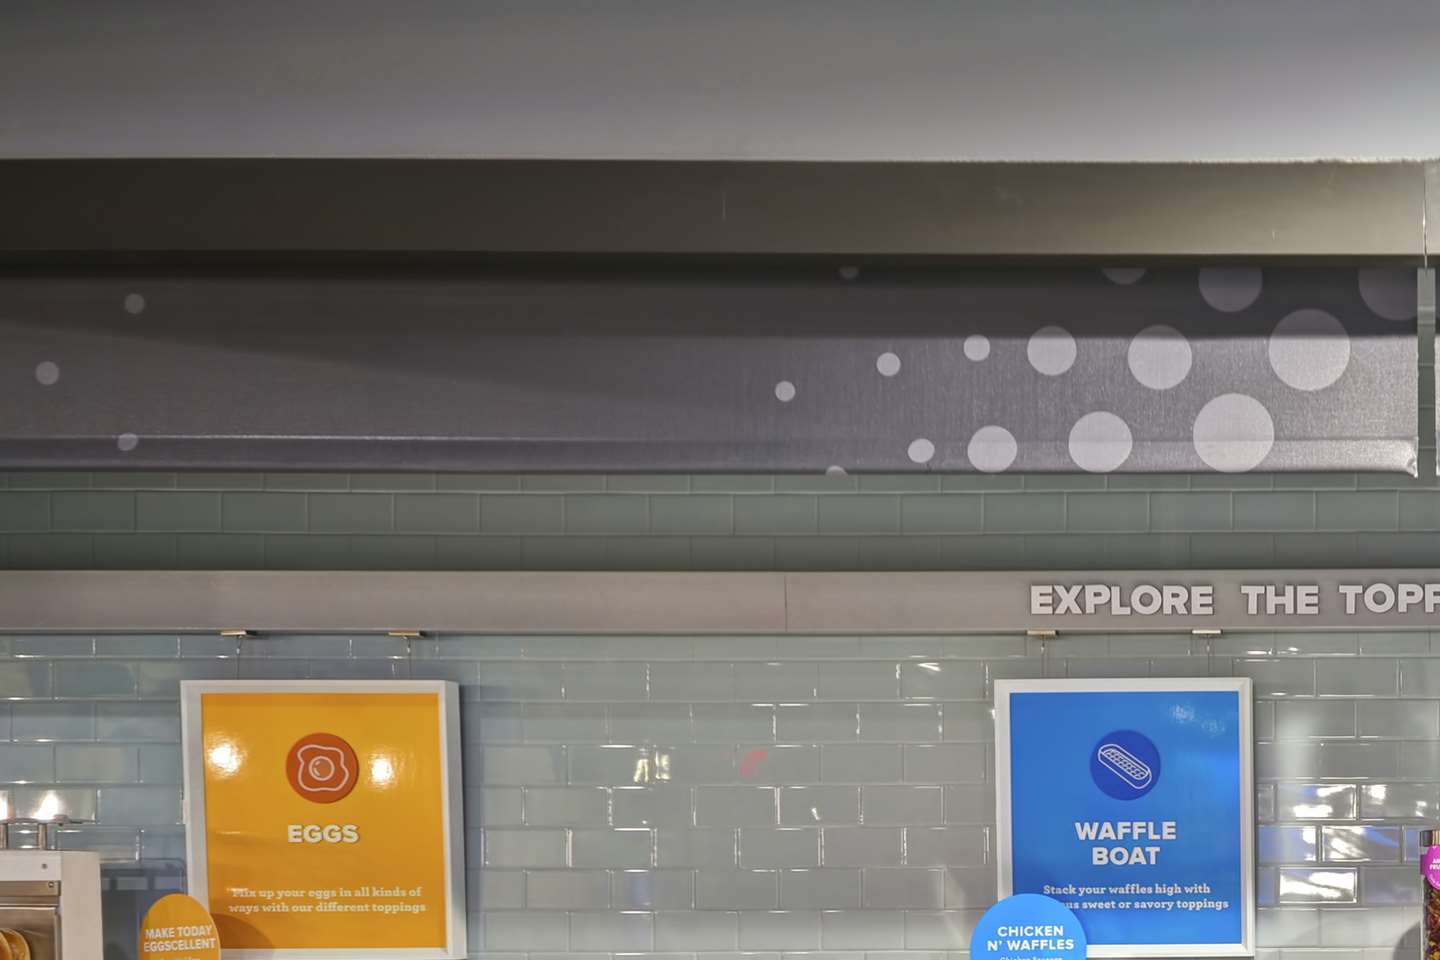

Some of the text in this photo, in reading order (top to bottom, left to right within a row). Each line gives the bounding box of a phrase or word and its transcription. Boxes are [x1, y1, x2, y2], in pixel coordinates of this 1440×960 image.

[1030, 584, 1214, 615] EXPLORE
[1240, 584, 1319, 615] THE
[287, 824, 360, 843] EGGS
[1074, 821, 1177, 840] WAFFLE
[1092, 847, 1160, 865] BOAT
[258, 889, 275, 899] up
[276, 889, 305, 899] your
[308, 889, 336, 899] eggs
[339, 887, 352, 897] in
[354, 887, 370, 897] all
[372, 887, 406, 897] kinds
[408, 887, 422, 897] of
[1043, 883, 1210, 896] Stack your waffles high with
[228, 902, 426, 914] ways with our different toppings
[1082, 900, 1116, 909] sweet
[1118, 901, 1131, 909] or
[1134, 901, 1173, 911] savory
[1176, 900, 1229, 911] toppings
[144, 924, 213, 939] MAKE TODAY
[997, 925, 1064, 937] CHICKEN
[143, 937, 217, 952] EGGSCELLENT
[987, 939, 1074, 952] N' WAFFLES
